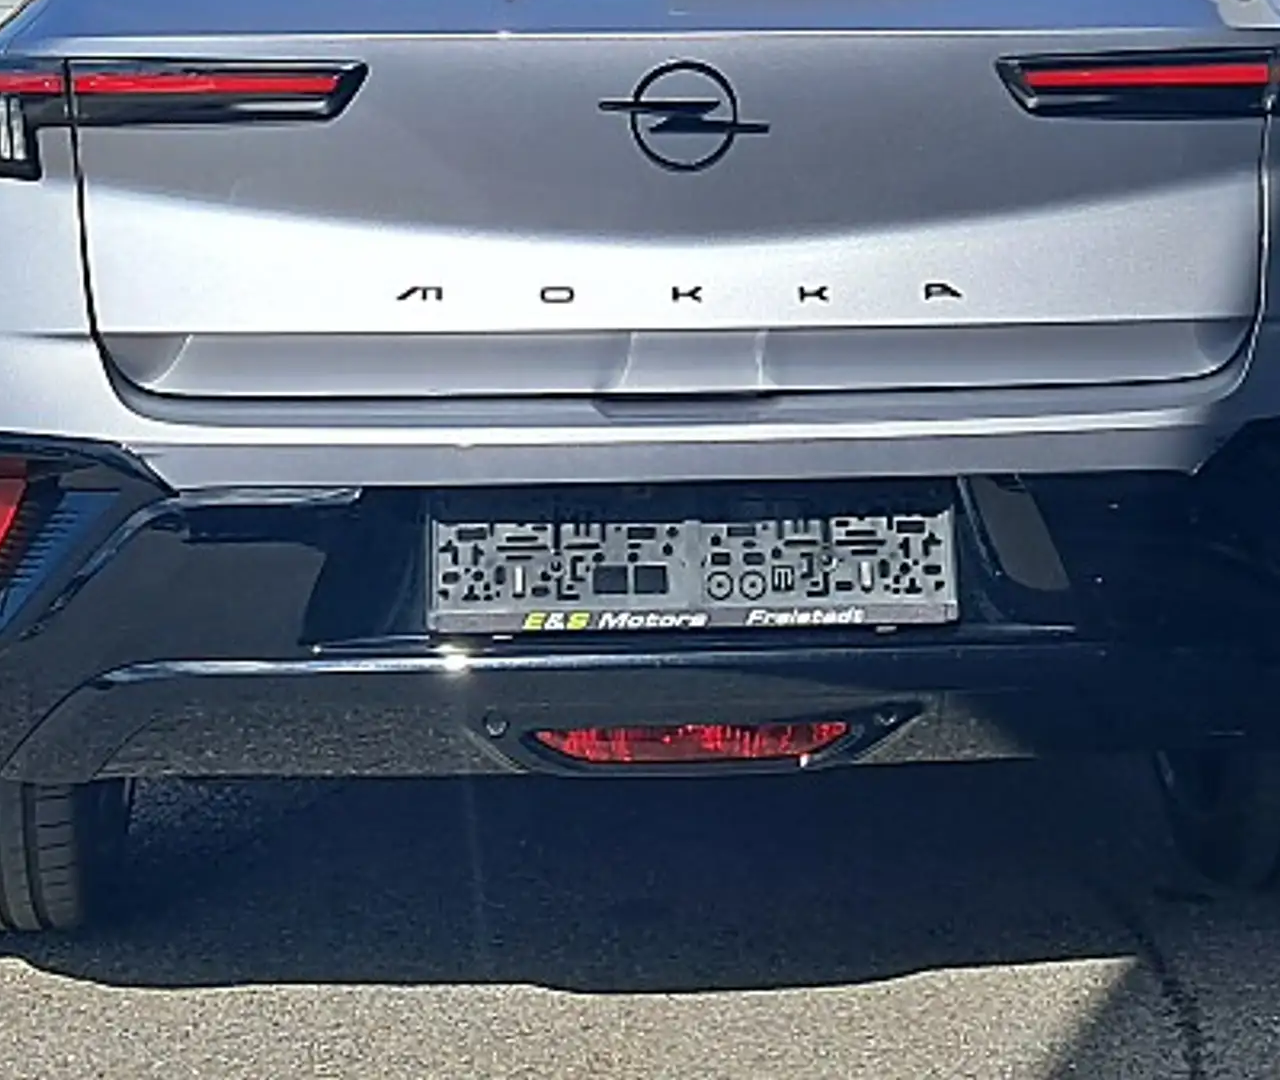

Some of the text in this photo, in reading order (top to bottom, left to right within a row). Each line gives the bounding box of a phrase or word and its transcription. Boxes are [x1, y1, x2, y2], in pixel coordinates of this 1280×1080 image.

[396, 282, 963, 304] MOKKA
[522, 610, 591, 631] E&S
[597, 611, 709, 630] Motors
